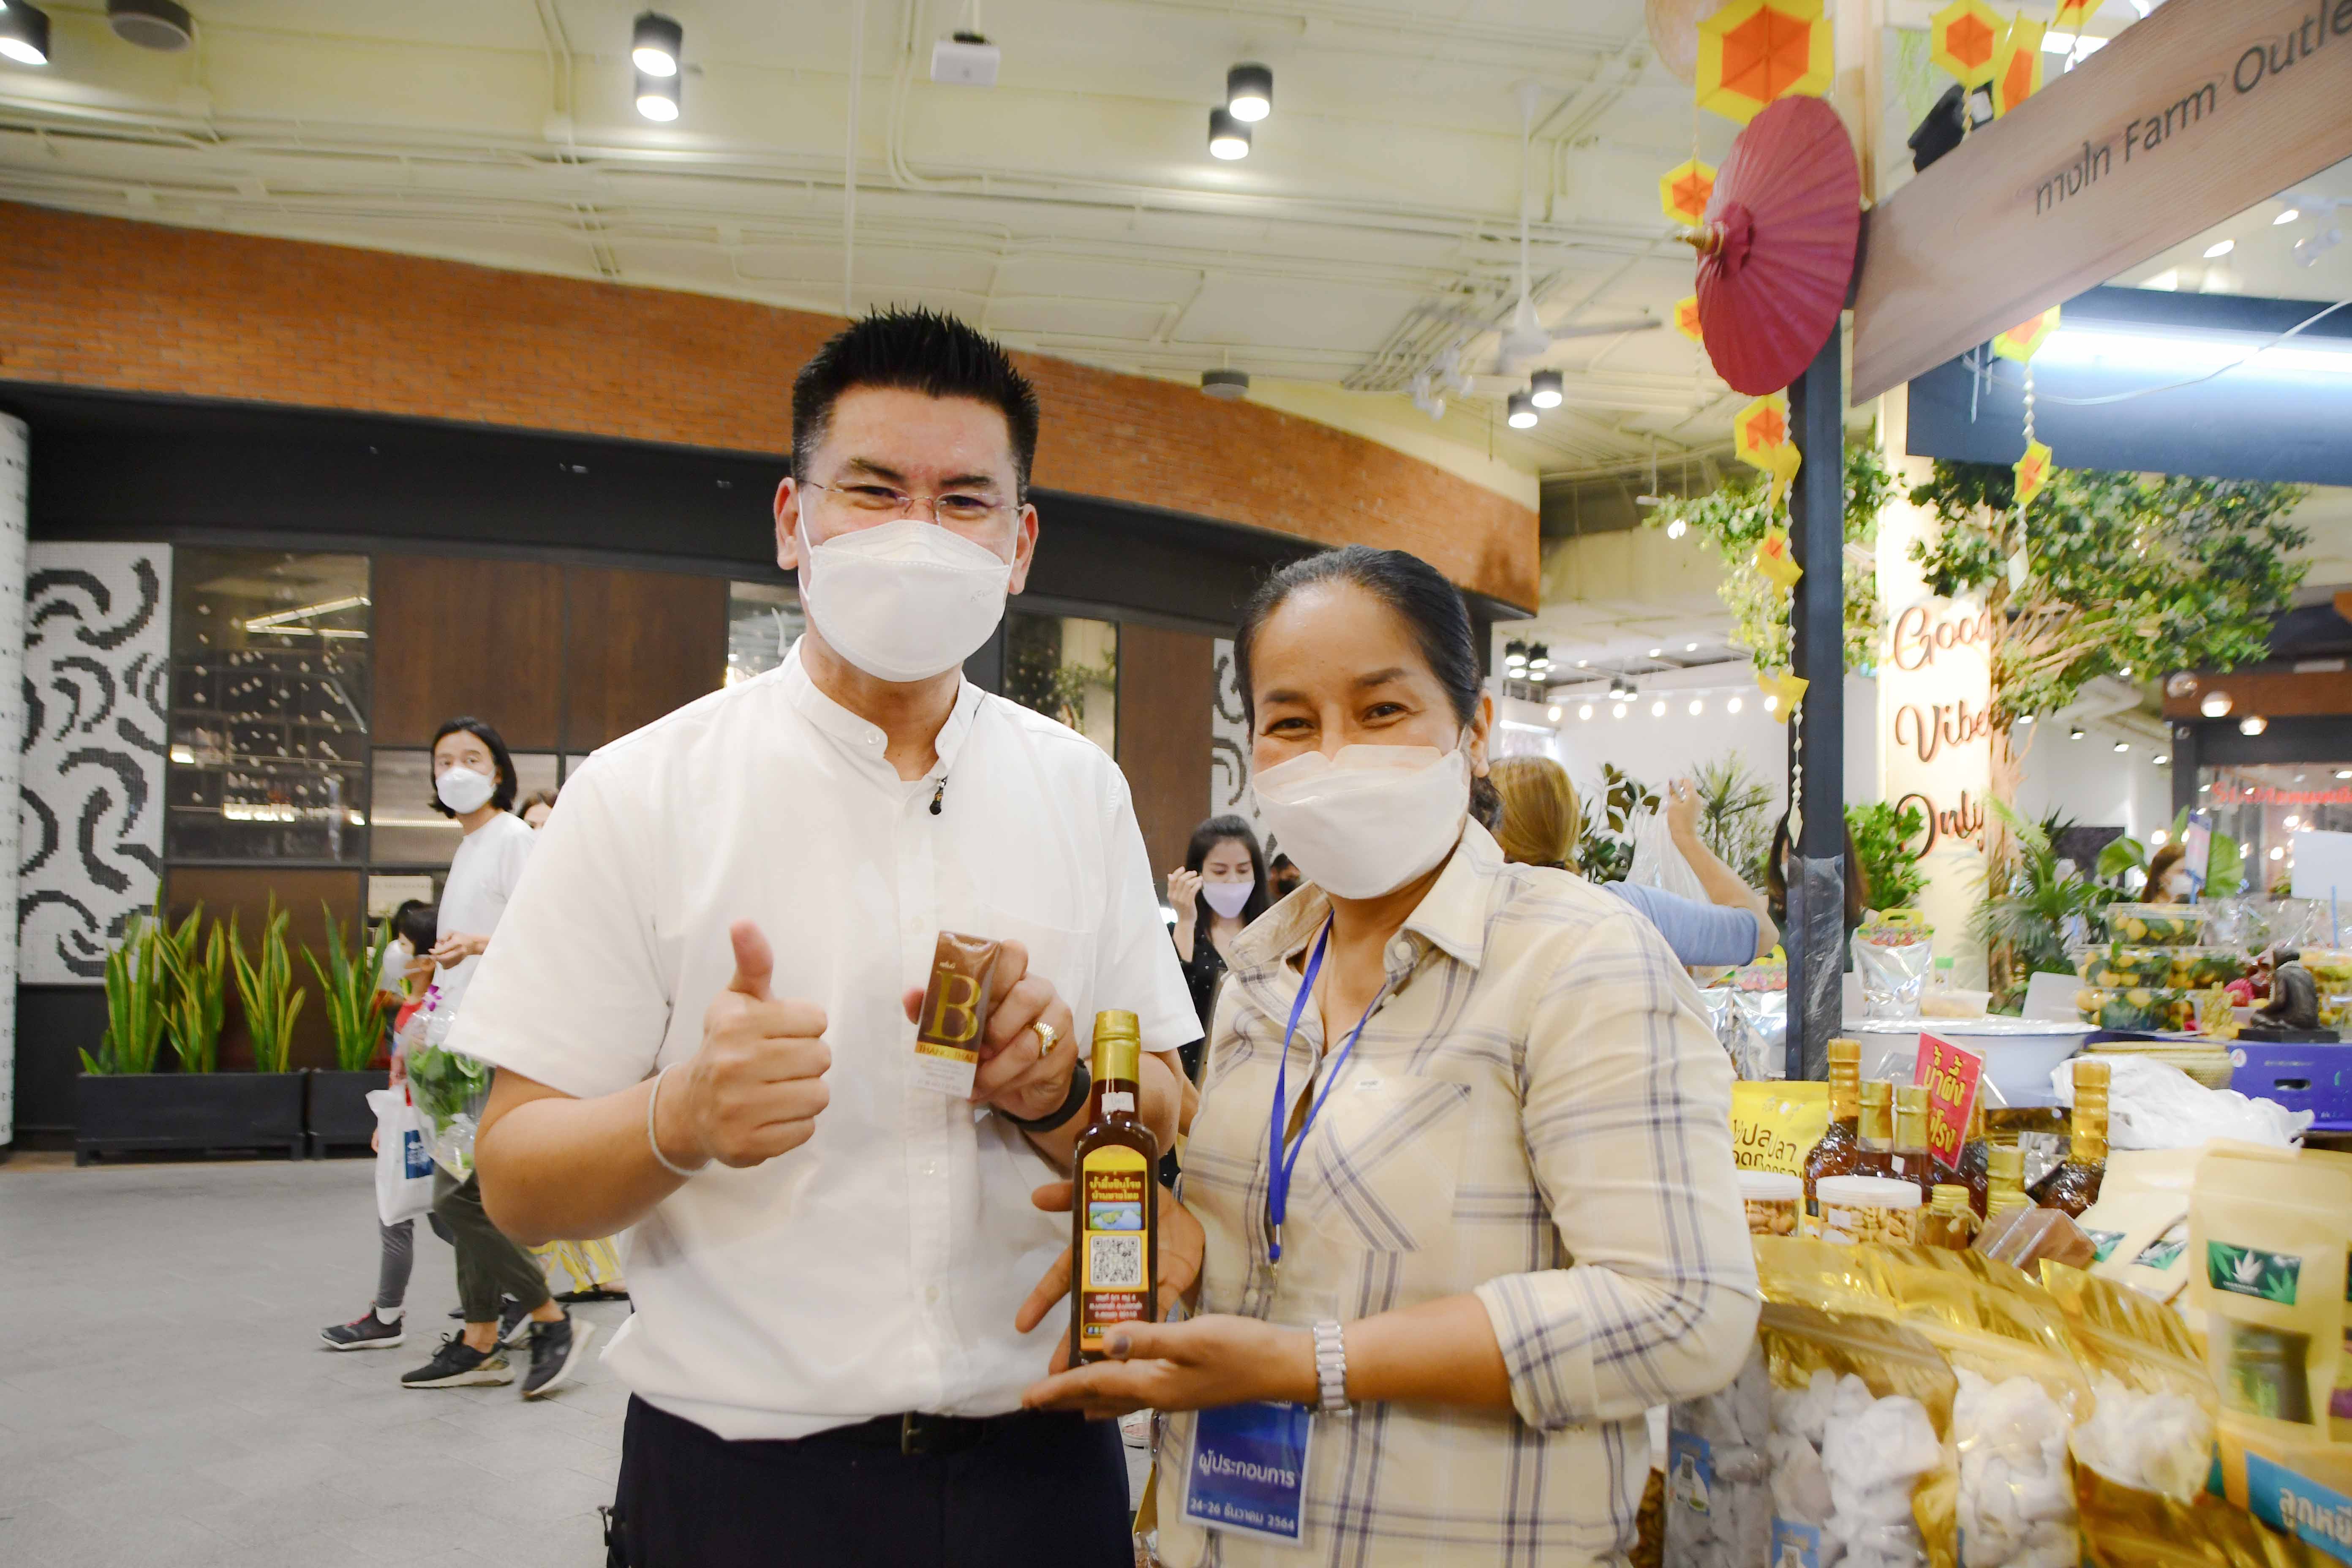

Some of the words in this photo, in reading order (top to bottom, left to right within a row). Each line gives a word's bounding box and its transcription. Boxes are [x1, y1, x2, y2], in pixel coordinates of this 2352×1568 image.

[2126, 82, 2216, 163] Farm
[925, 971, 982, 1043] B
[1268, 1514, 1295, 1532] 2564
